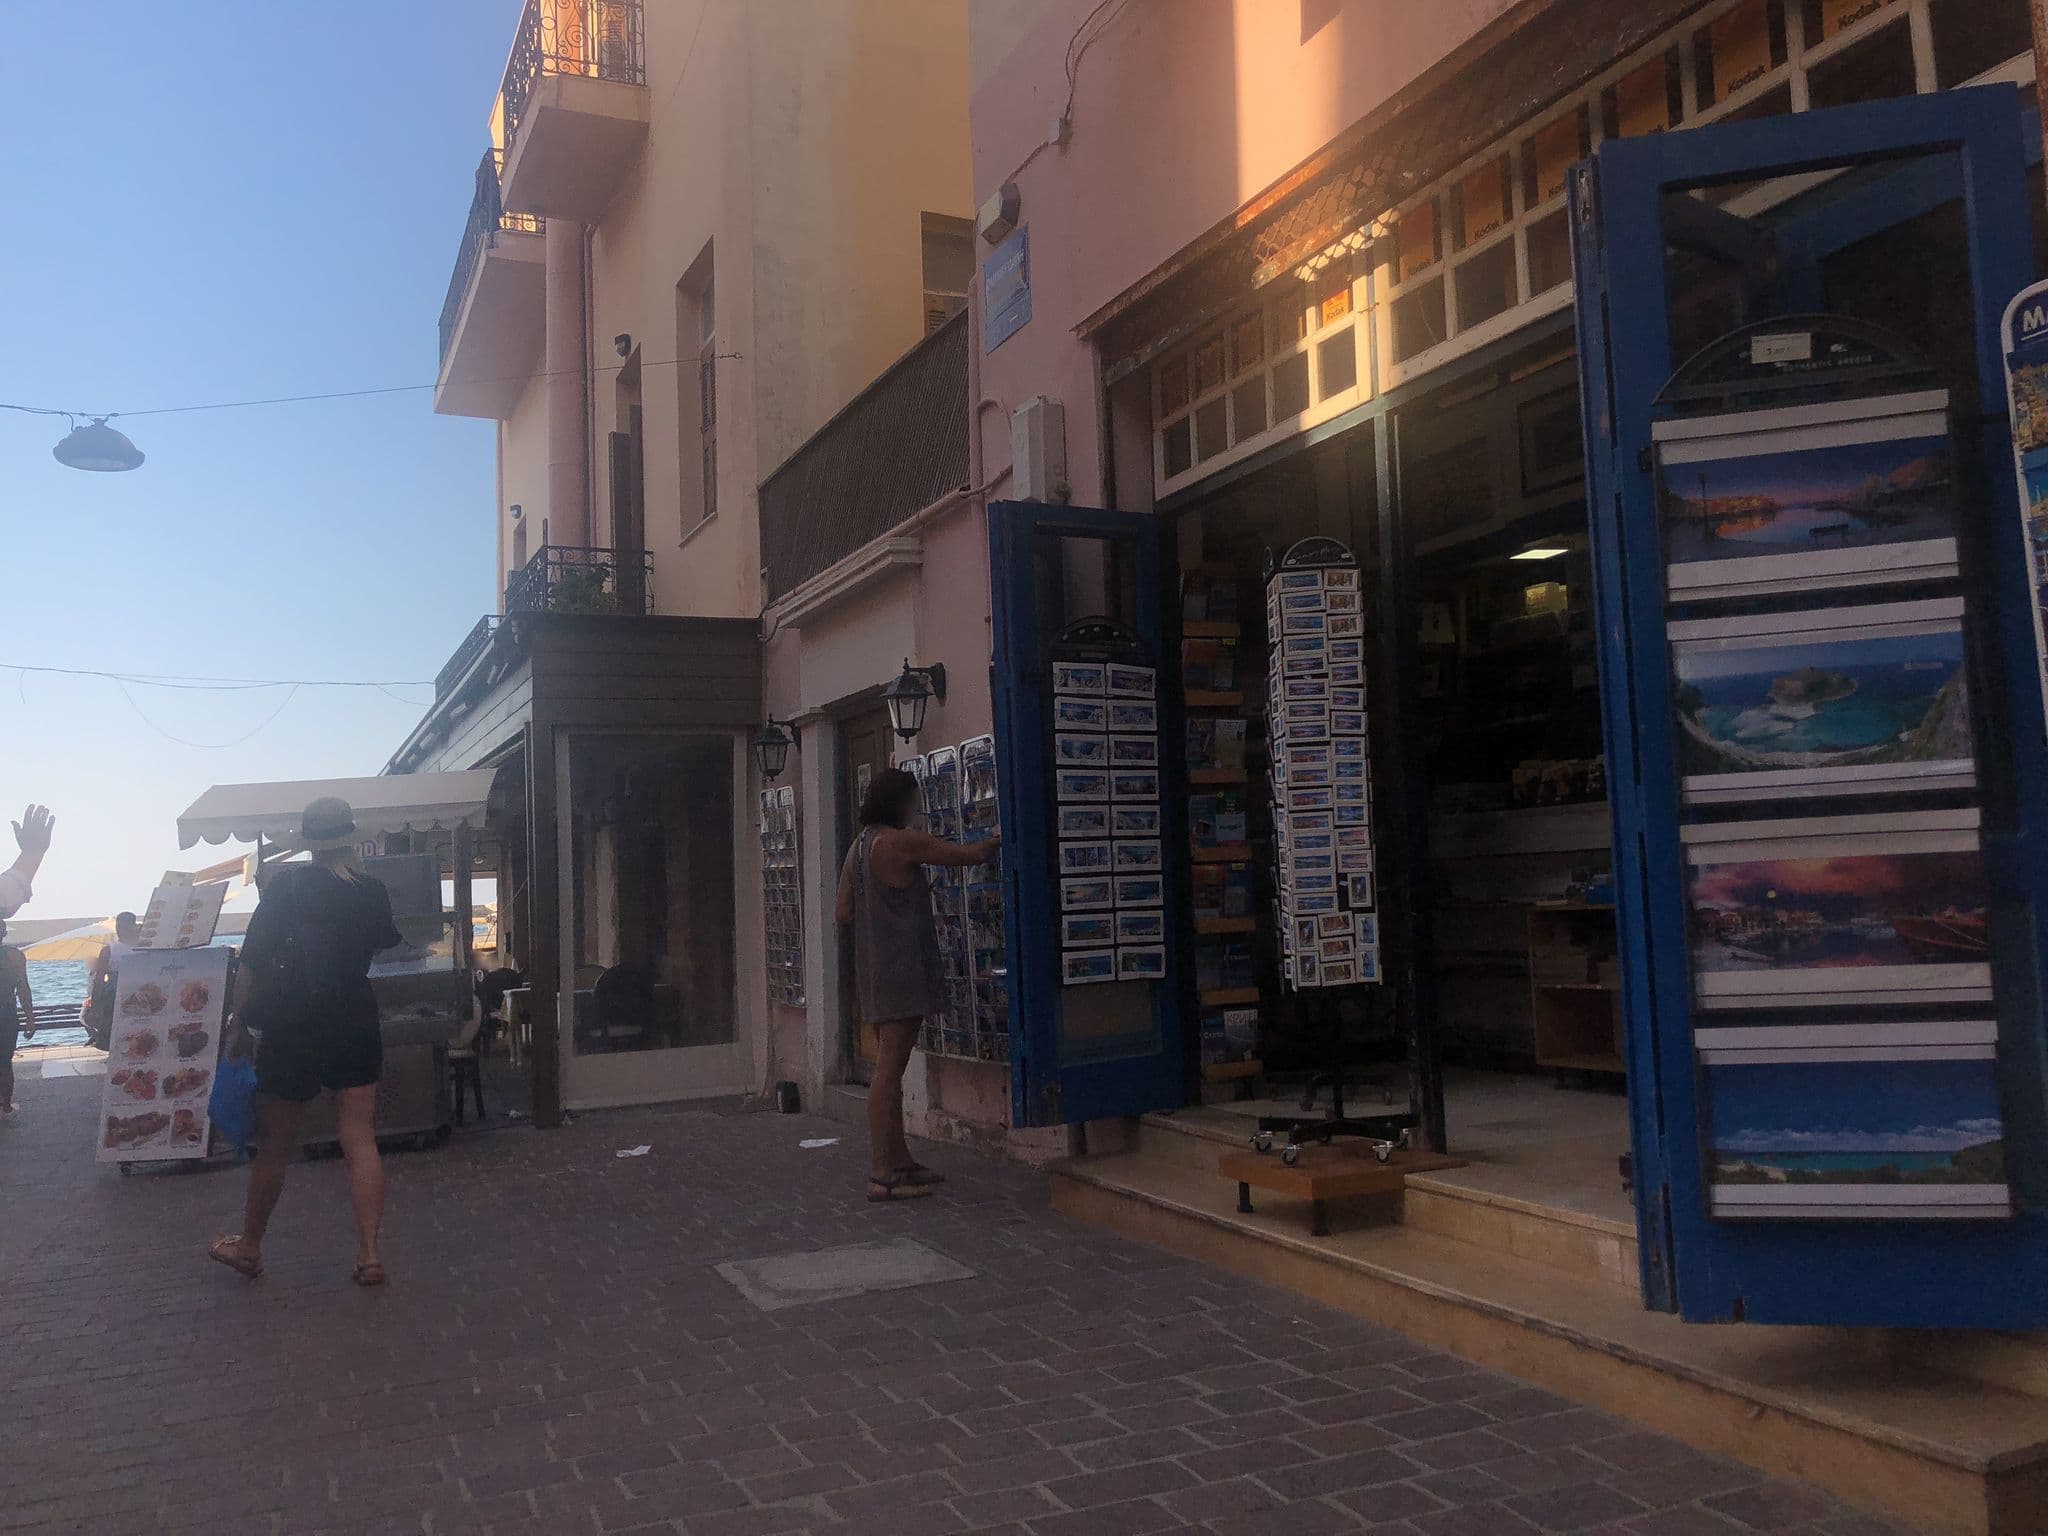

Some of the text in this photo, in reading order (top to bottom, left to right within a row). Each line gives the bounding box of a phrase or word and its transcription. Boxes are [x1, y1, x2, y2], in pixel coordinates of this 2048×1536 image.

[1838, 0, 1881, 28] Kodak
[1728, 64, 1766, 93] Kodak
[1473, 218, 1501, 241] Kodak
[1326, 304, 1345, 320] Kodak
[2022, 304, 2048, 332] M
